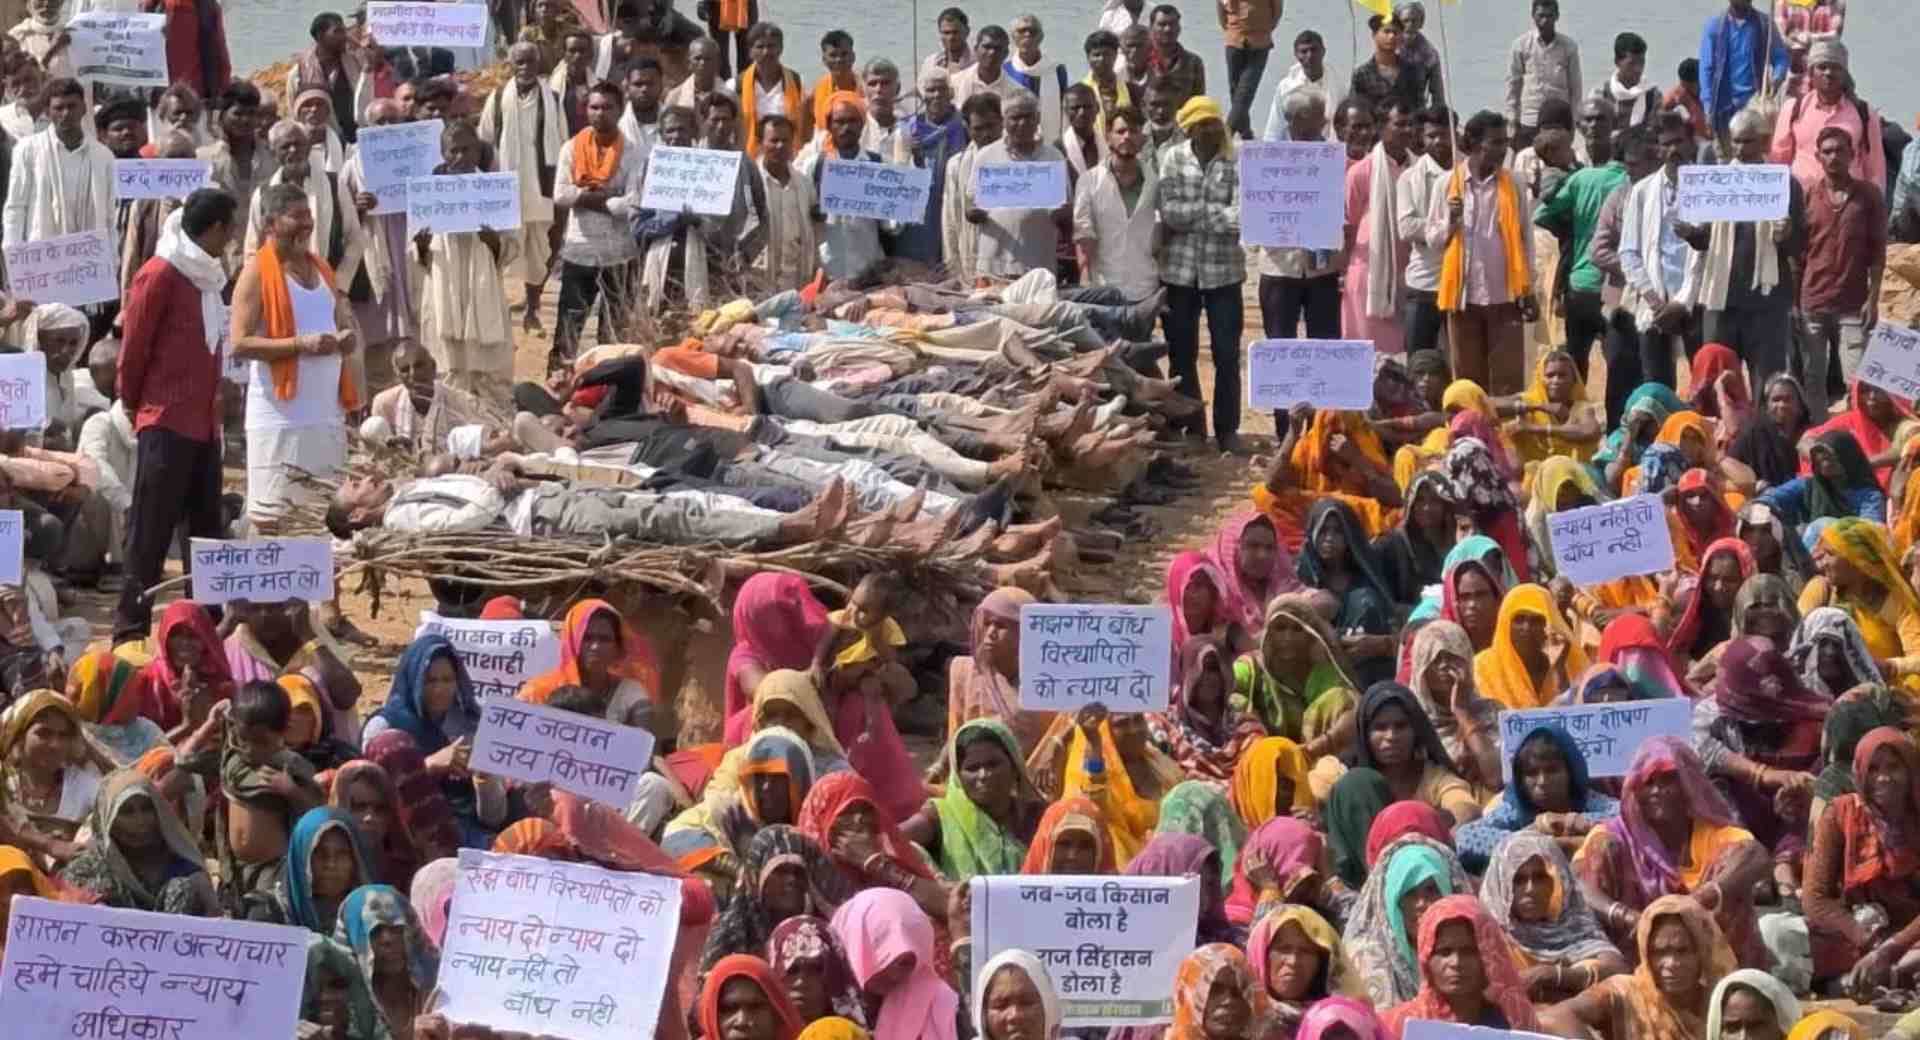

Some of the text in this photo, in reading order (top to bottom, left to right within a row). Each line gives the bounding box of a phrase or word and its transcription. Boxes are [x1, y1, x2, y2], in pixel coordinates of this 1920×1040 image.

[196, 542, 284, 566] जमीन ली
[258, 570, 297, 591] मत
[298, 563, 321, 590] लो
[509, 626, 538, 648] की
[1032, 669, 1155, 705] को न्याय दो
[487, 706, 616, 751] जय जवान
[1570, 714, 1595, 734] का
[1600, 706, 1652, 731] शोषण
[488, 740, 637, 792] जय किसान
[638, 891, 667, 917] को
[1020, 881, 1170, 905] जब-जब किसान
[1065, 906, 1129, 932] बोला है
[14, 914, 298, 967] शासन करता अत्याचार
[459, 914, 645, 964] न्याय दो न्याय दो
[451, 950, 504, 980] न्याय
[552, 954, 582, 986] तो
[1076, 943, 1153, 968] सिंहासन
[70, 957, 155, 998] चाहिये
[160, 972, 259, 1007] न्याय
[1060, 969, 1122, 995] डोला है
[71, 1006, 197, 1040] अधिकार
